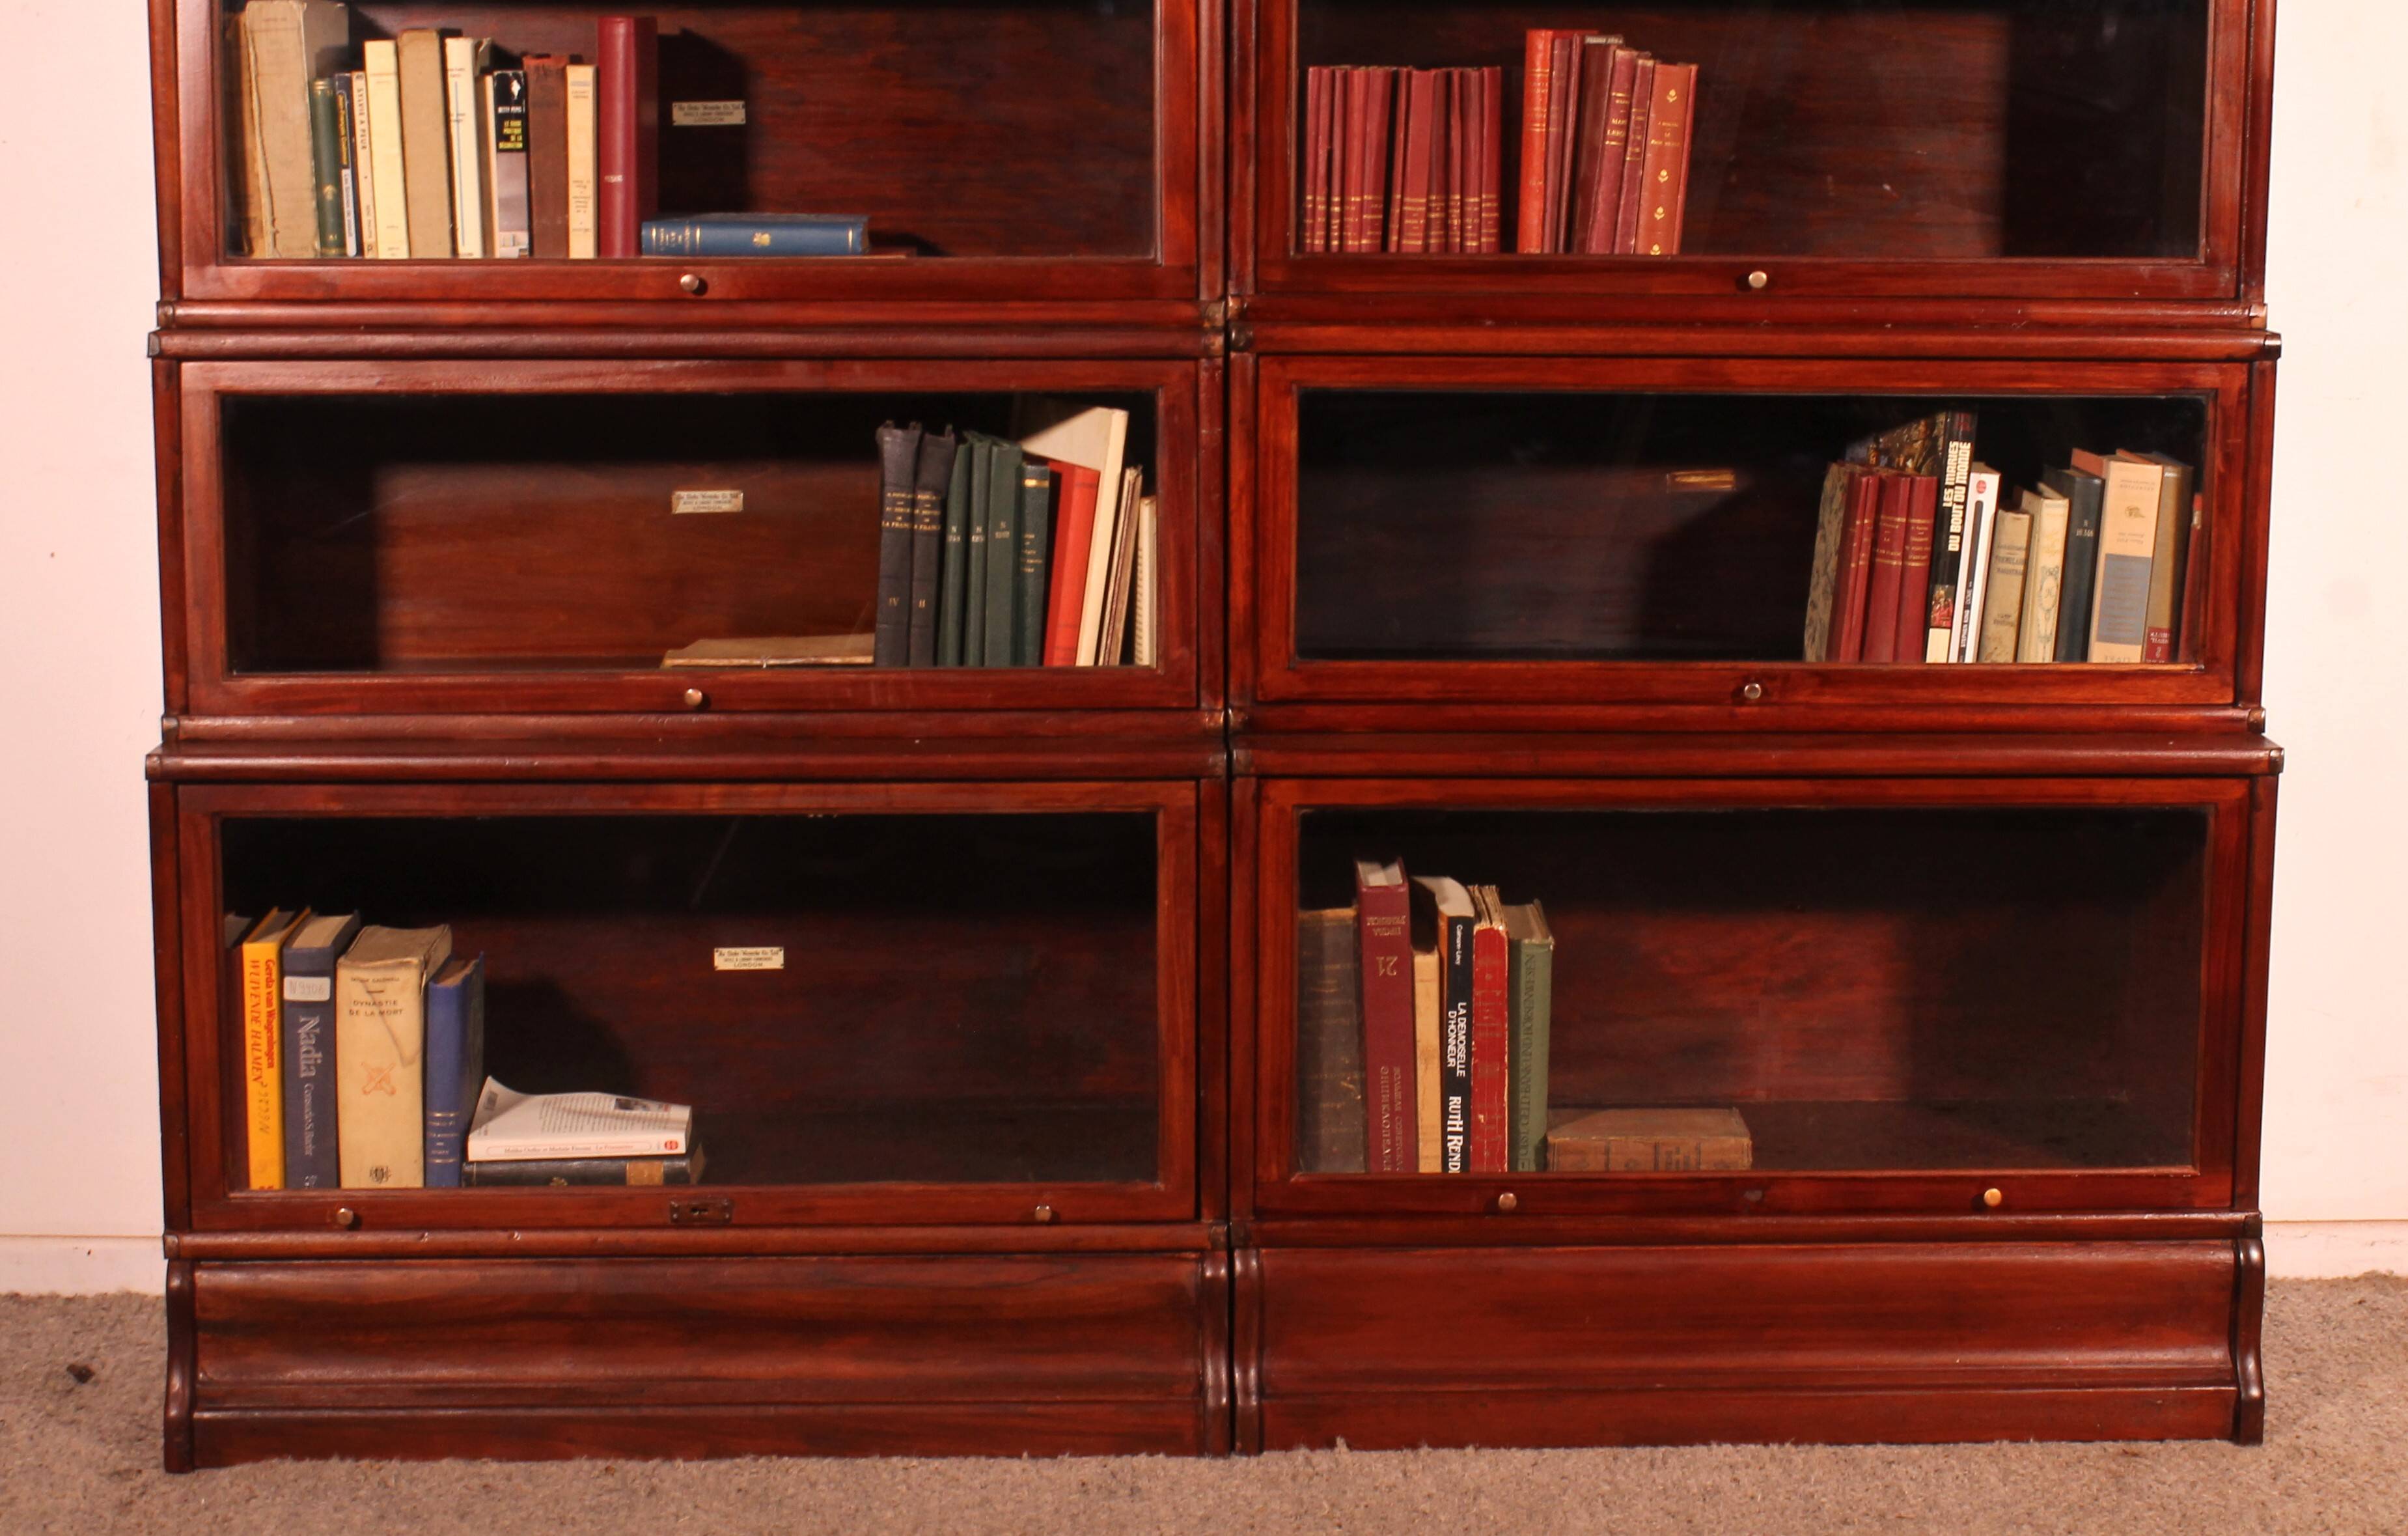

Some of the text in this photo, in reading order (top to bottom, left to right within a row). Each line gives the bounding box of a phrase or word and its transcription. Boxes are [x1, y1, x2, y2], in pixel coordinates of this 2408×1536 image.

[1943, 441, 1959, 507] LES MARIES
[1948, 442, 1971, 552] DU BOUT DU MONDE
[1376, 956, 1398, 976] 21
[264, 959, 277, 1068] Gerda van Wageningen
[1447, 1011, 1458, 1068] D'HONNEUR
[1456, 1001, 1467, 1077] LA DEMOISELLE
[251, 1029, 262, 1083] HALMEN
[298, 1015, 323, 1078] Nadia
[1447, 1096, 1463, 1132] RUTH
